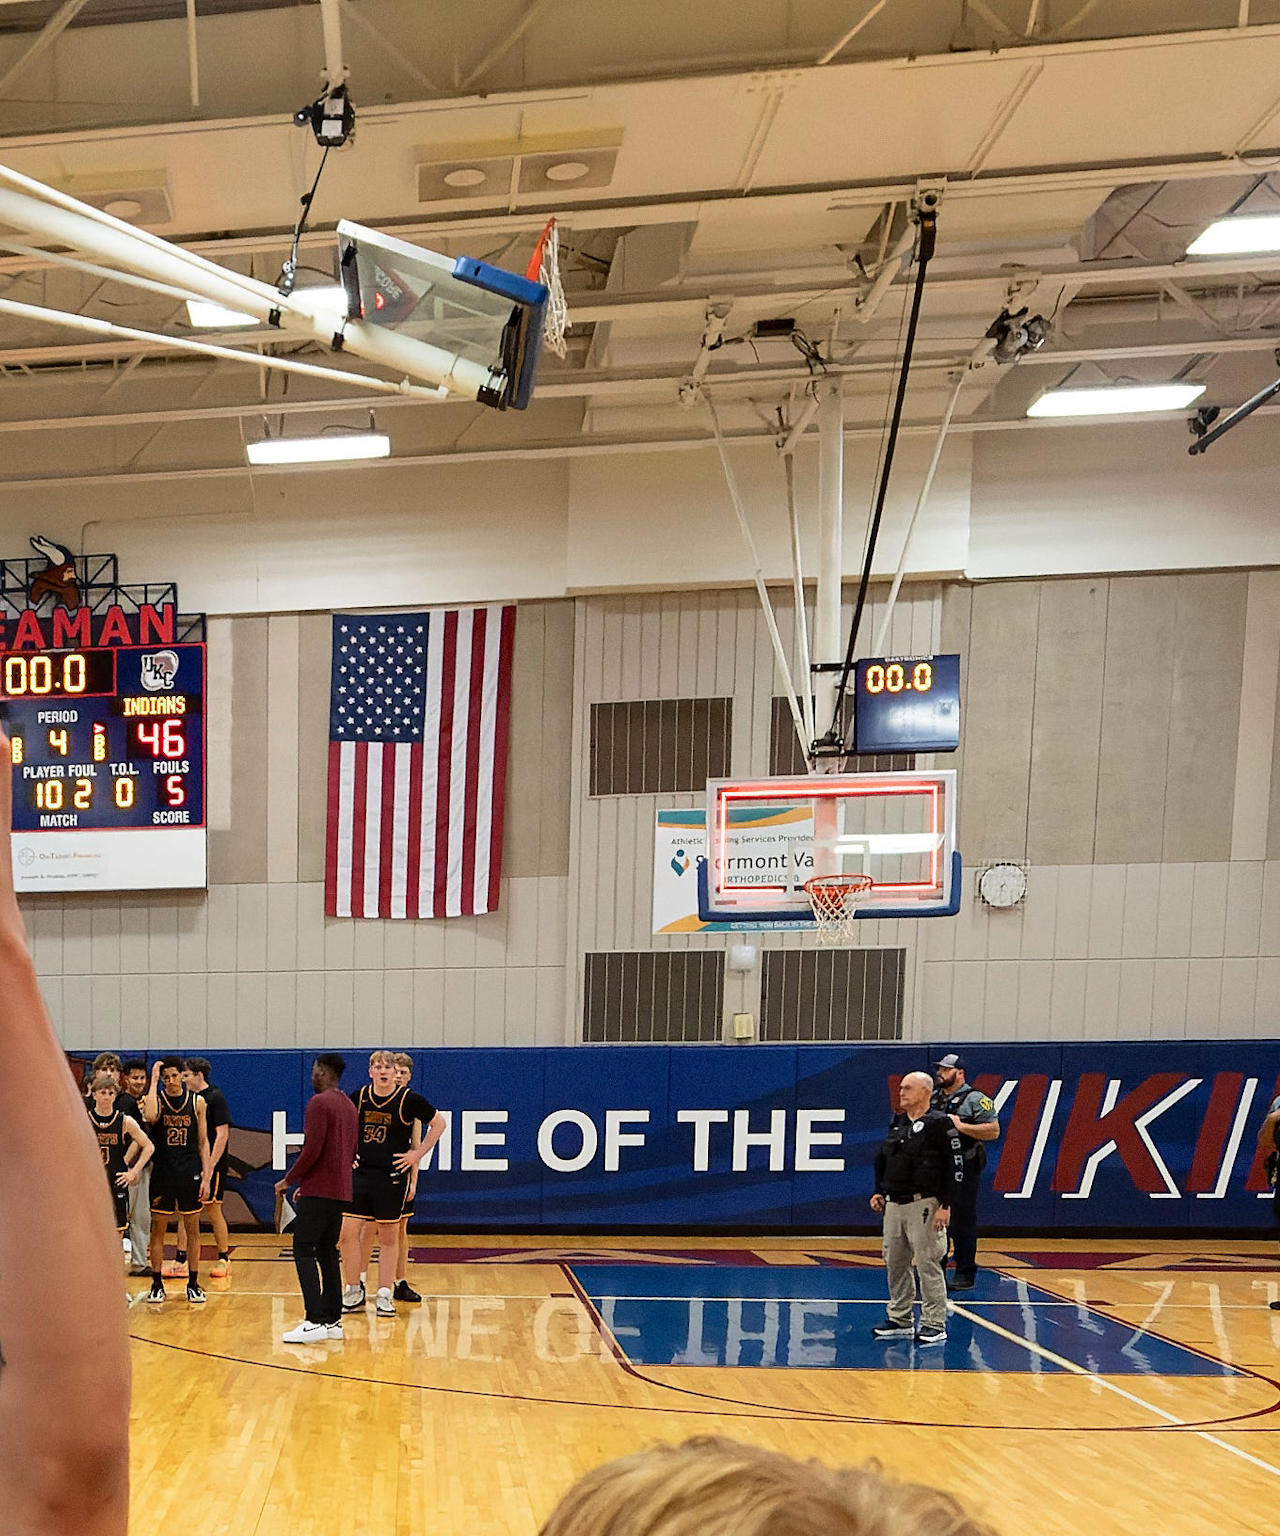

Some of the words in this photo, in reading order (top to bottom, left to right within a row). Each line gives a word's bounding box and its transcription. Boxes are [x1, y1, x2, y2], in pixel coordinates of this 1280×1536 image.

[5, 654, 86, 695] 00.0
[866, 662, 932, 694] 00.0
[38, 710, 79, 724] PERIOD
[123, 695, 186, 717] INDIANS
[50, 730, 67, 756] 4
[138, 720, 185, 758] 46
[23, 765, 65, 779] PLAYER
[68, 764, 97, 778] FOUL
[109, 763, 139, 776] T.O.L.
[153, 761, 190, 774] FOULS
[36, 779, 63, 809] 10
[74, 779, 93, 809] 2
[115, 778, 134, 808] 0
[167, 775, 185, 806] 5
[40, 814, 78, 827] MATCH
[152, 811, 190, 824] SCORE
[672, 837, 704, 846] Athletic
[742, 836, 776, 844] Services
[167, 1127, 188, 1146] 21
[538, 1109, 649, 1172] OF
[677, 1109, 845, 1171] THE
